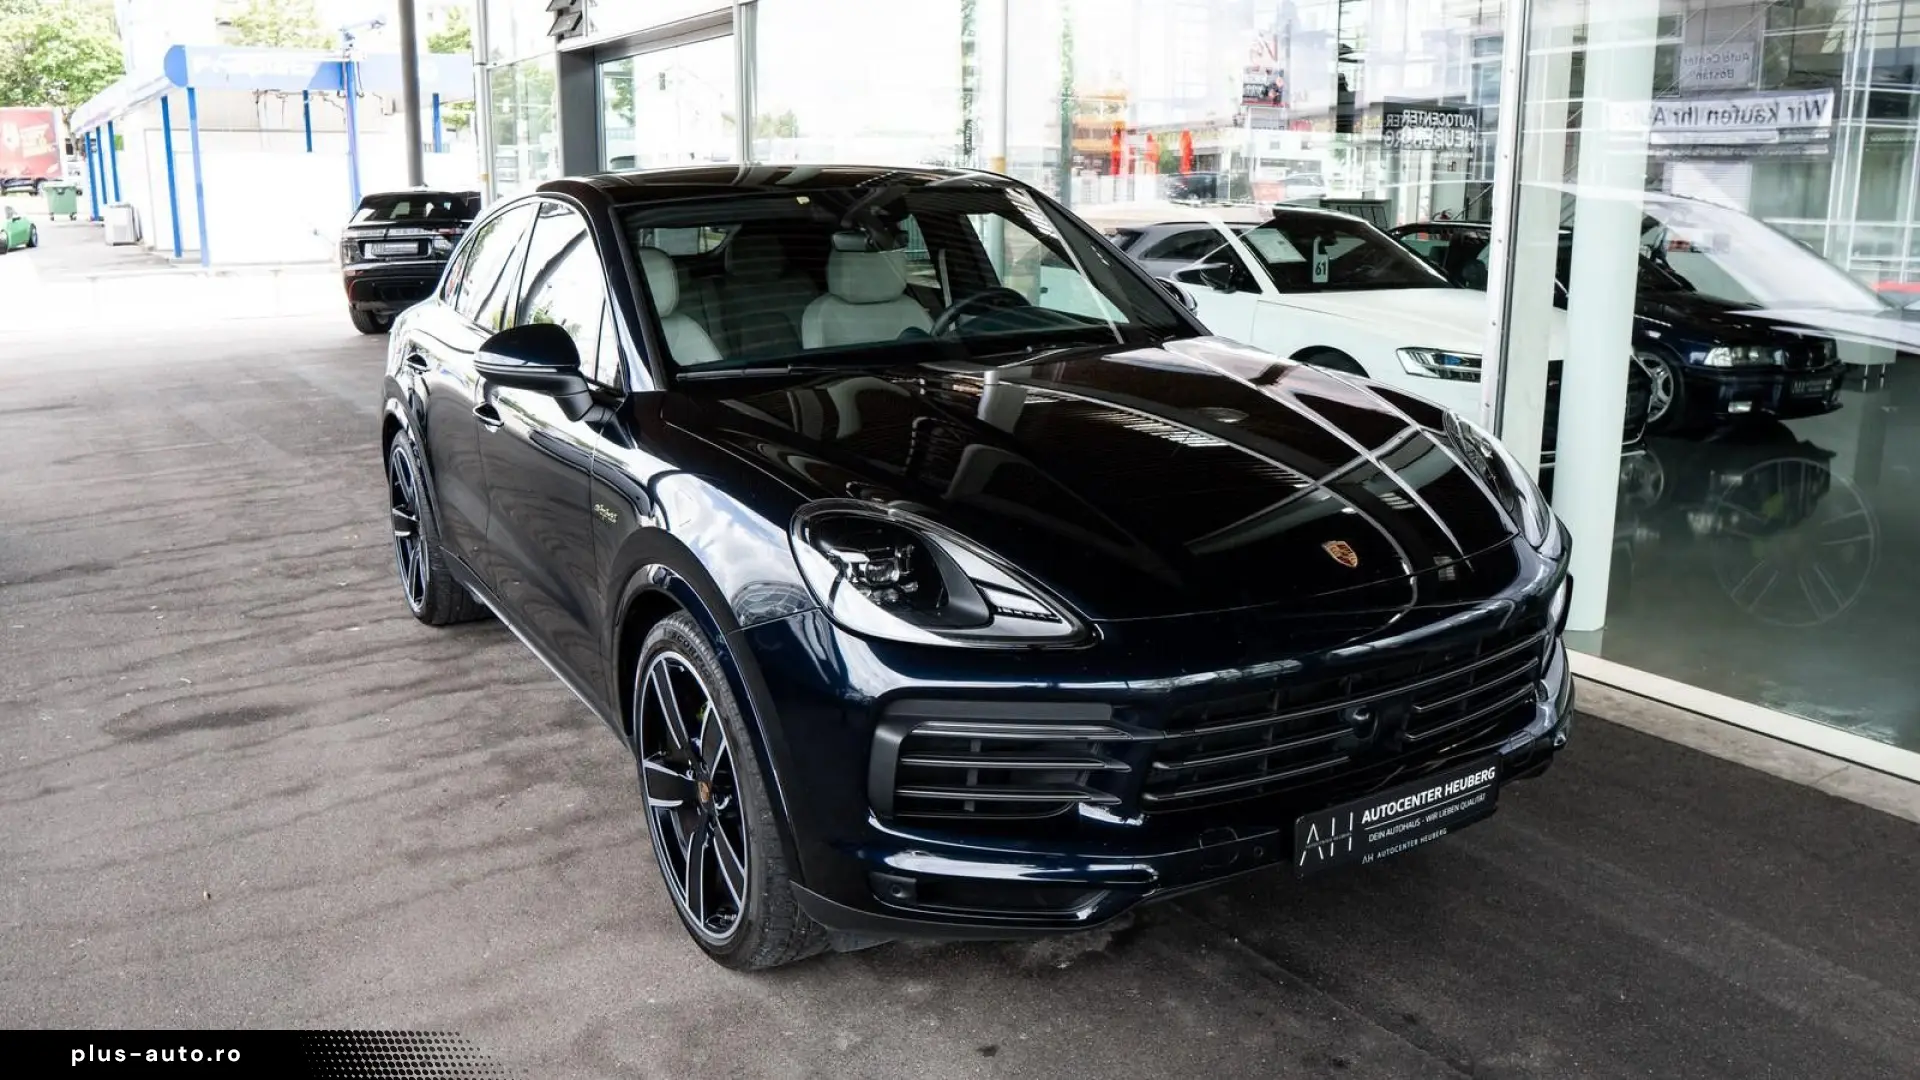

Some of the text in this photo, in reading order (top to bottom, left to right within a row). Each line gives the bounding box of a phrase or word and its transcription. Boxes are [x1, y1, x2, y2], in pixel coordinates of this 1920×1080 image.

[1315, 262, 1327, 276] 61
[1361, 766, 1497, 825] AUTOCENTER HEUBERG
[1299, 811, 1354, 866] AH
[1368, 830, 1385, 842] DEIN
[1385, 817, 1421, 837] AUTOHAUS
[1425, 811, 1439, 823] WIR
[1361, 852, 1374, 865] AH
[1377, 838, 1418, 859] AUTOCENTER
